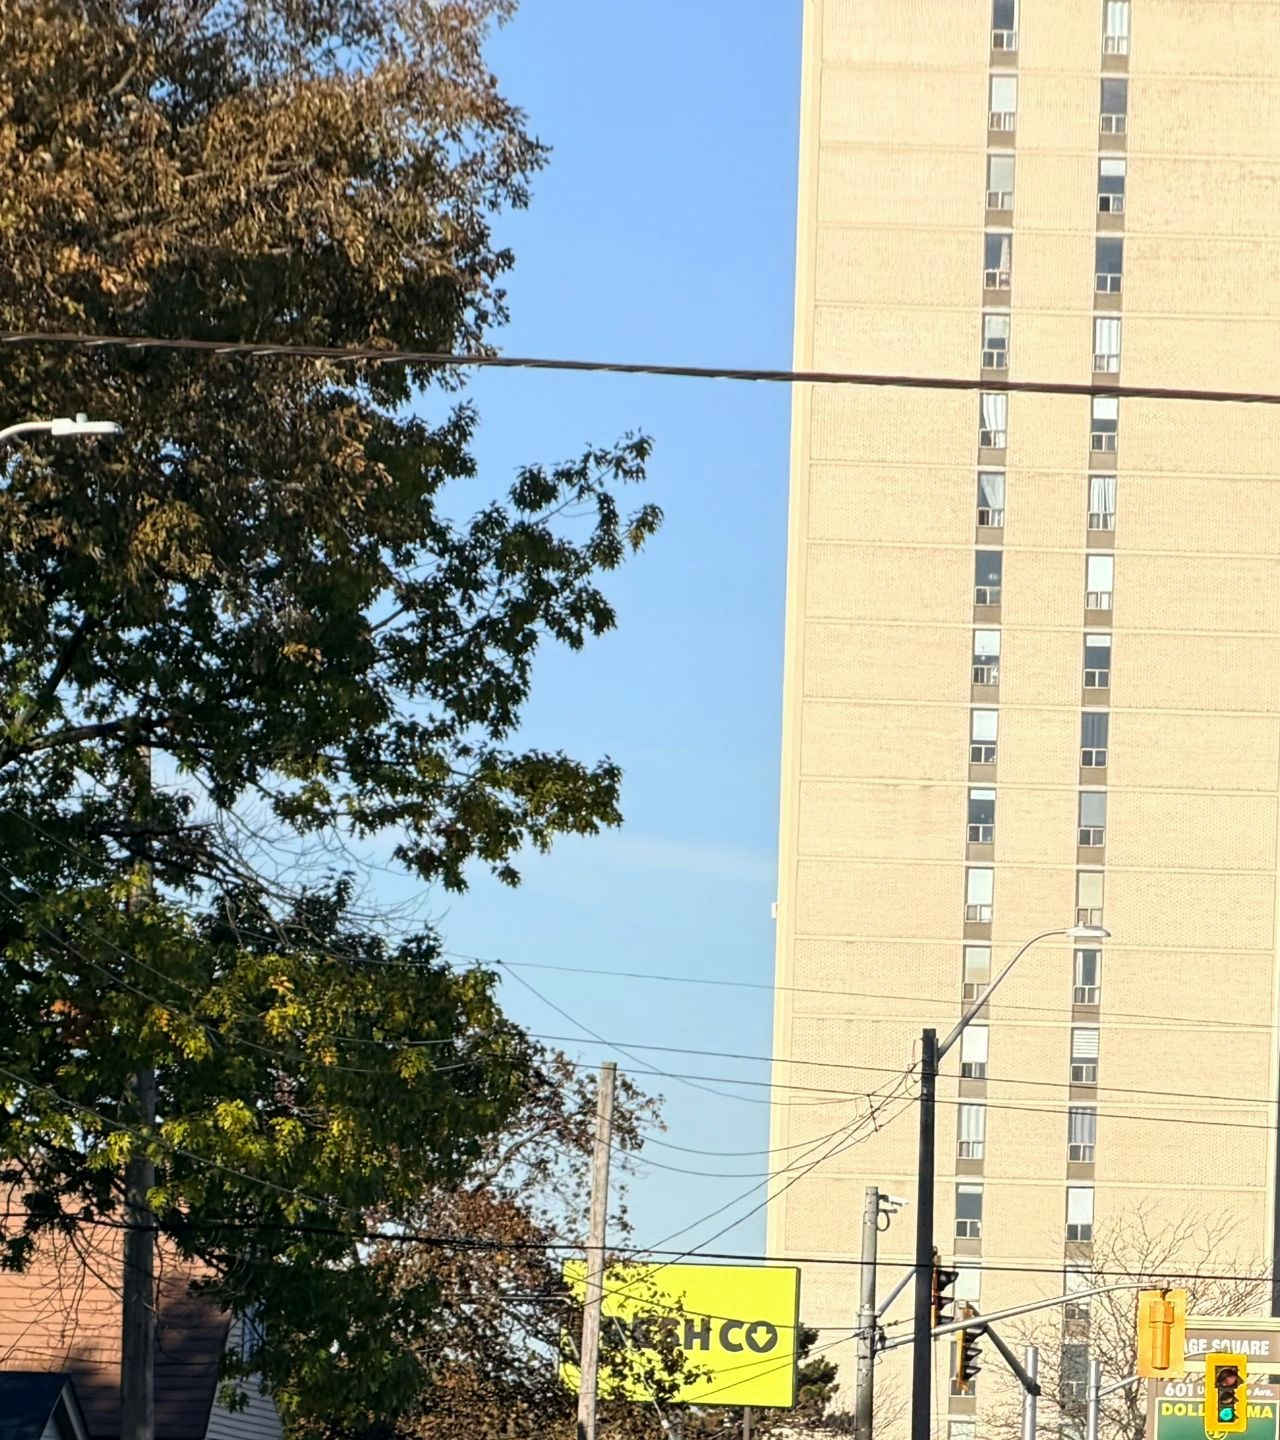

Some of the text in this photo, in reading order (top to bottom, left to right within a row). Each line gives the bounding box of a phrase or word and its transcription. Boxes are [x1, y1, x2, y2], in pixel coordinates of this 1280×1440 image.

[1211, 1340, 1270, 1356] SQUARE
[1164, 1383, 1194, 1397] 601
[1161, 1403, 1273, 1418] DOLLMA
